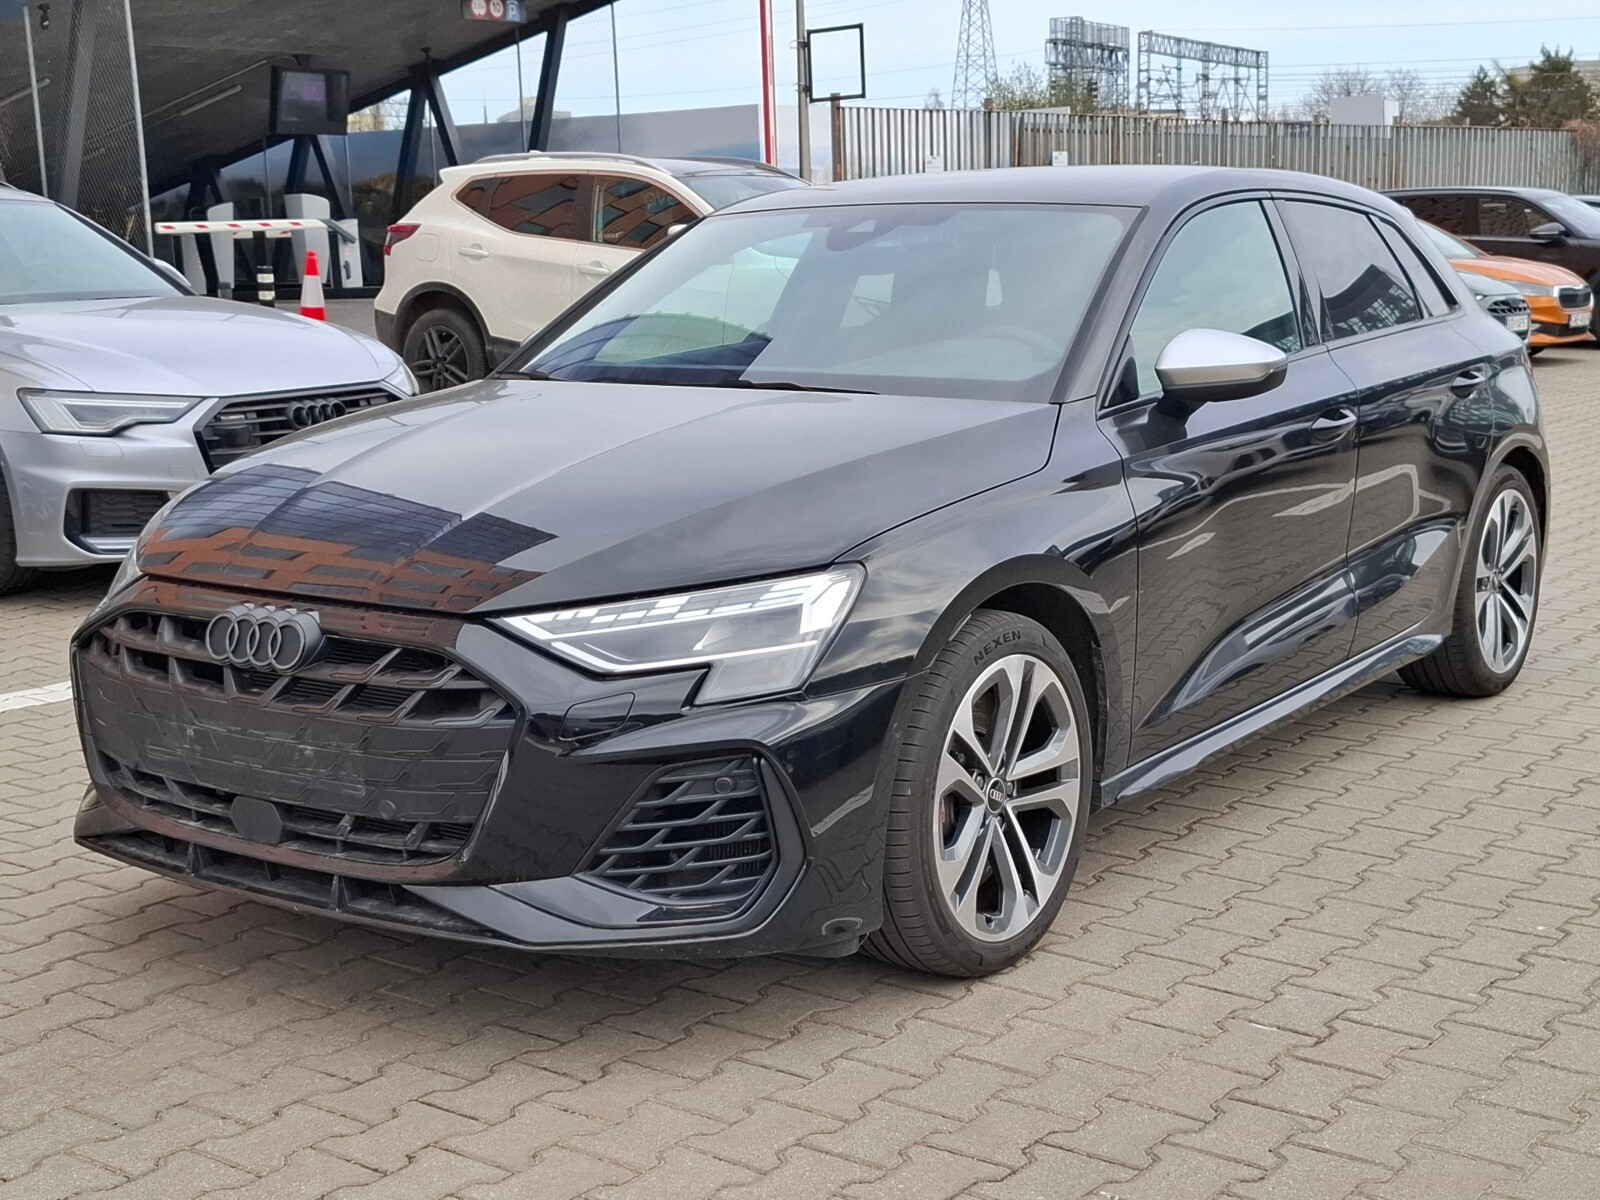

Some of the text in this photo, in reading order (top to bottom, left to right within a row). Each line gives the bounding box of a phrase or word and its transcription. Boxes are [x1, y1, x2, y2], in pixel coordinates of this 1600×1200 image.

[492, 2, 501, 13] 10
[508, 4, 517, 18] P
[973, 630, 1021, 665] NEXEN
